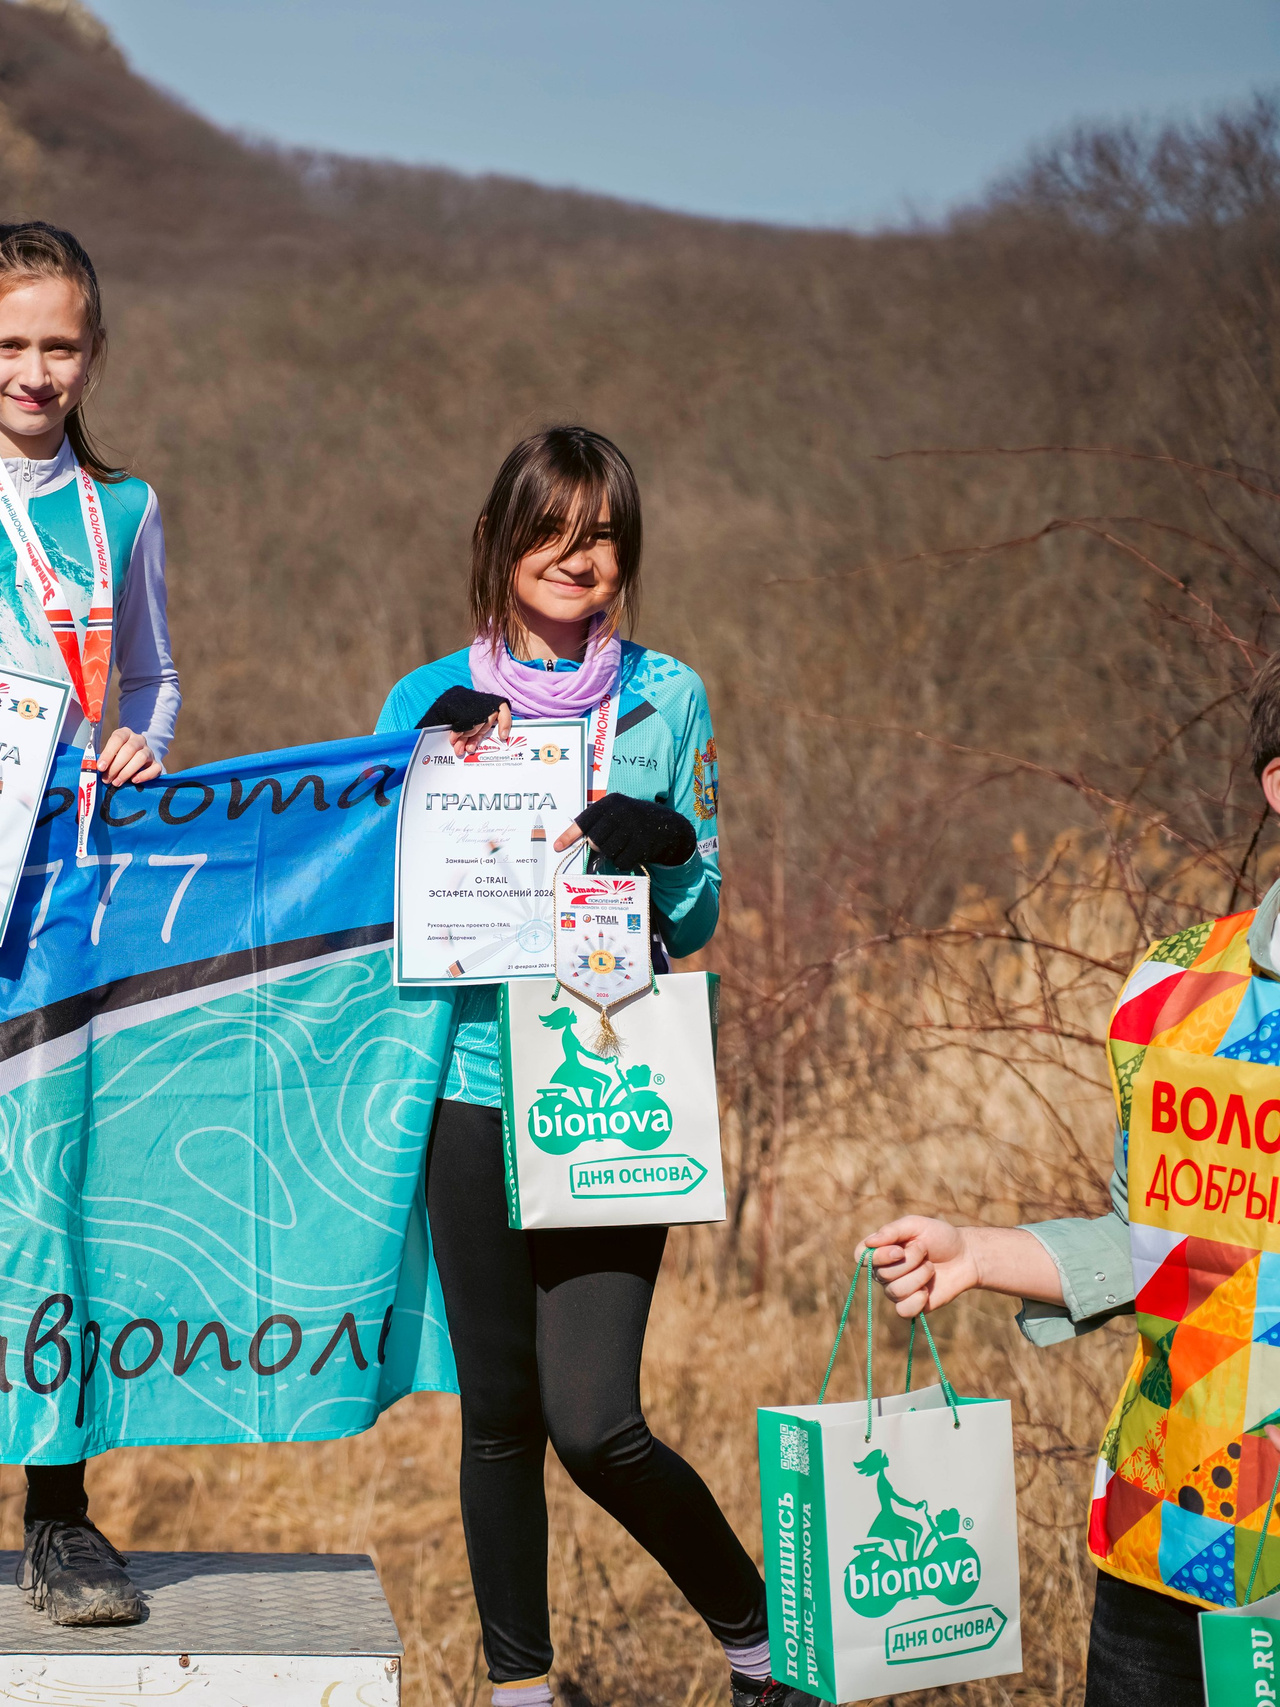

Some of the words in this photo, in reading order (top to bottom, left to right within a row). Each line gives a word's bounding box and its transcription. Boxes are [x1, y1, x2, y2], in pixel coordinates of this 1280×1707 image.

[80, 467, 93, 491] 202
[0, 494, 28, 543] ПОКОЛЕНИЙ
[92, 506, 109, 576] ЛЕРМОНТОВ
[25, 541, 56, 606] Эстафета
[593, 693, 612, 761] ЛЕРМОНТОВ
[422, 754, 455, 766] O-TRAIL
[36, 764, 397, 828] сота
[425, 792, 557, 811] ГРАМОТА
[23, 853, 208, 950] 777
[428, 889, 474, 898] ЭСТАФЕТА
[477, 888, 532, 897] ПОКОЛЕНИЙ
[534, 889, 554, 897] 2026
[474, 876, 508, 884] O-TRAIL
[563, 881, 609, 894] Эстафета
[532, 1103, 671, 1138] bionova
[1151, 1080, 1280, 1155] ВОЛО
[577, 1169, 615, 1189] ДНЯ
[619, 1165, 693, 1185] ОСНОВА
[1145, 1154, 1280, 1224] ДОБРЫ
[778, 1492, 799, 1680] ПОДПИШИСЬ
[802, 1502, 819, 1687] PUBLIC_BIONOVA
[848, 1557, 979, 1600] bionova
[892, 1630, 928, 1653] ДНЯ
[932, 1617, 996, 1644] ОСНОВА
